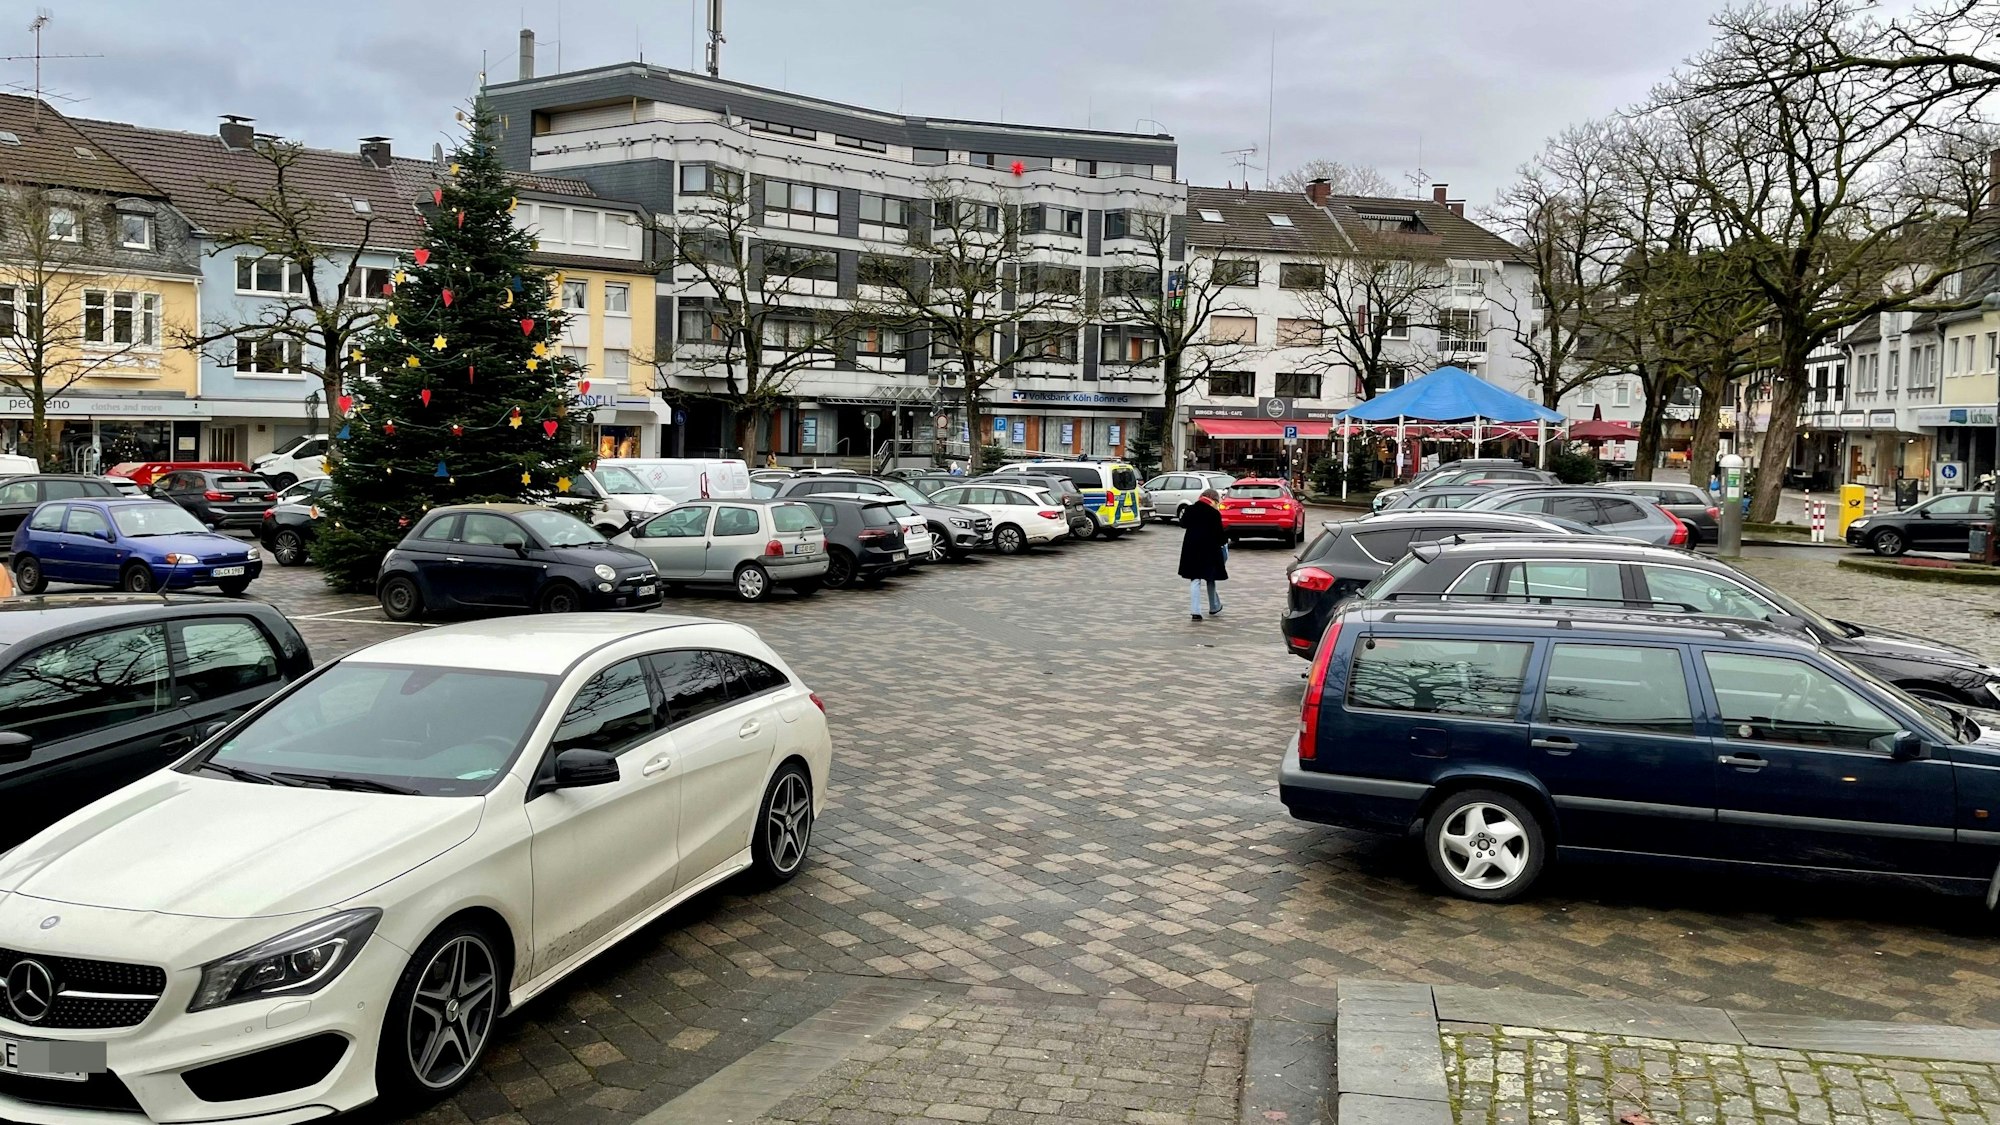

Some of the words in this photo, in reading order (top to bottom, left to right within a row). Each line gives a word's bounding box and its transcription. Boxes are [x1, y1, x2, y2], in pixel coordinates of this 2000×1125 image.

[1029, 392, 1071, 401] Volksbank
[1073, 393, 1091, 402] Köln
[1093, 394, 1115, 403] Bonn
[1117, 395, 1128, 403] eG
[9, 399, 70, 411] peeno
[91, 402, 121, 411] clothes
[123, 403, 139, 411] and
[141, 404, 162, 412] more
